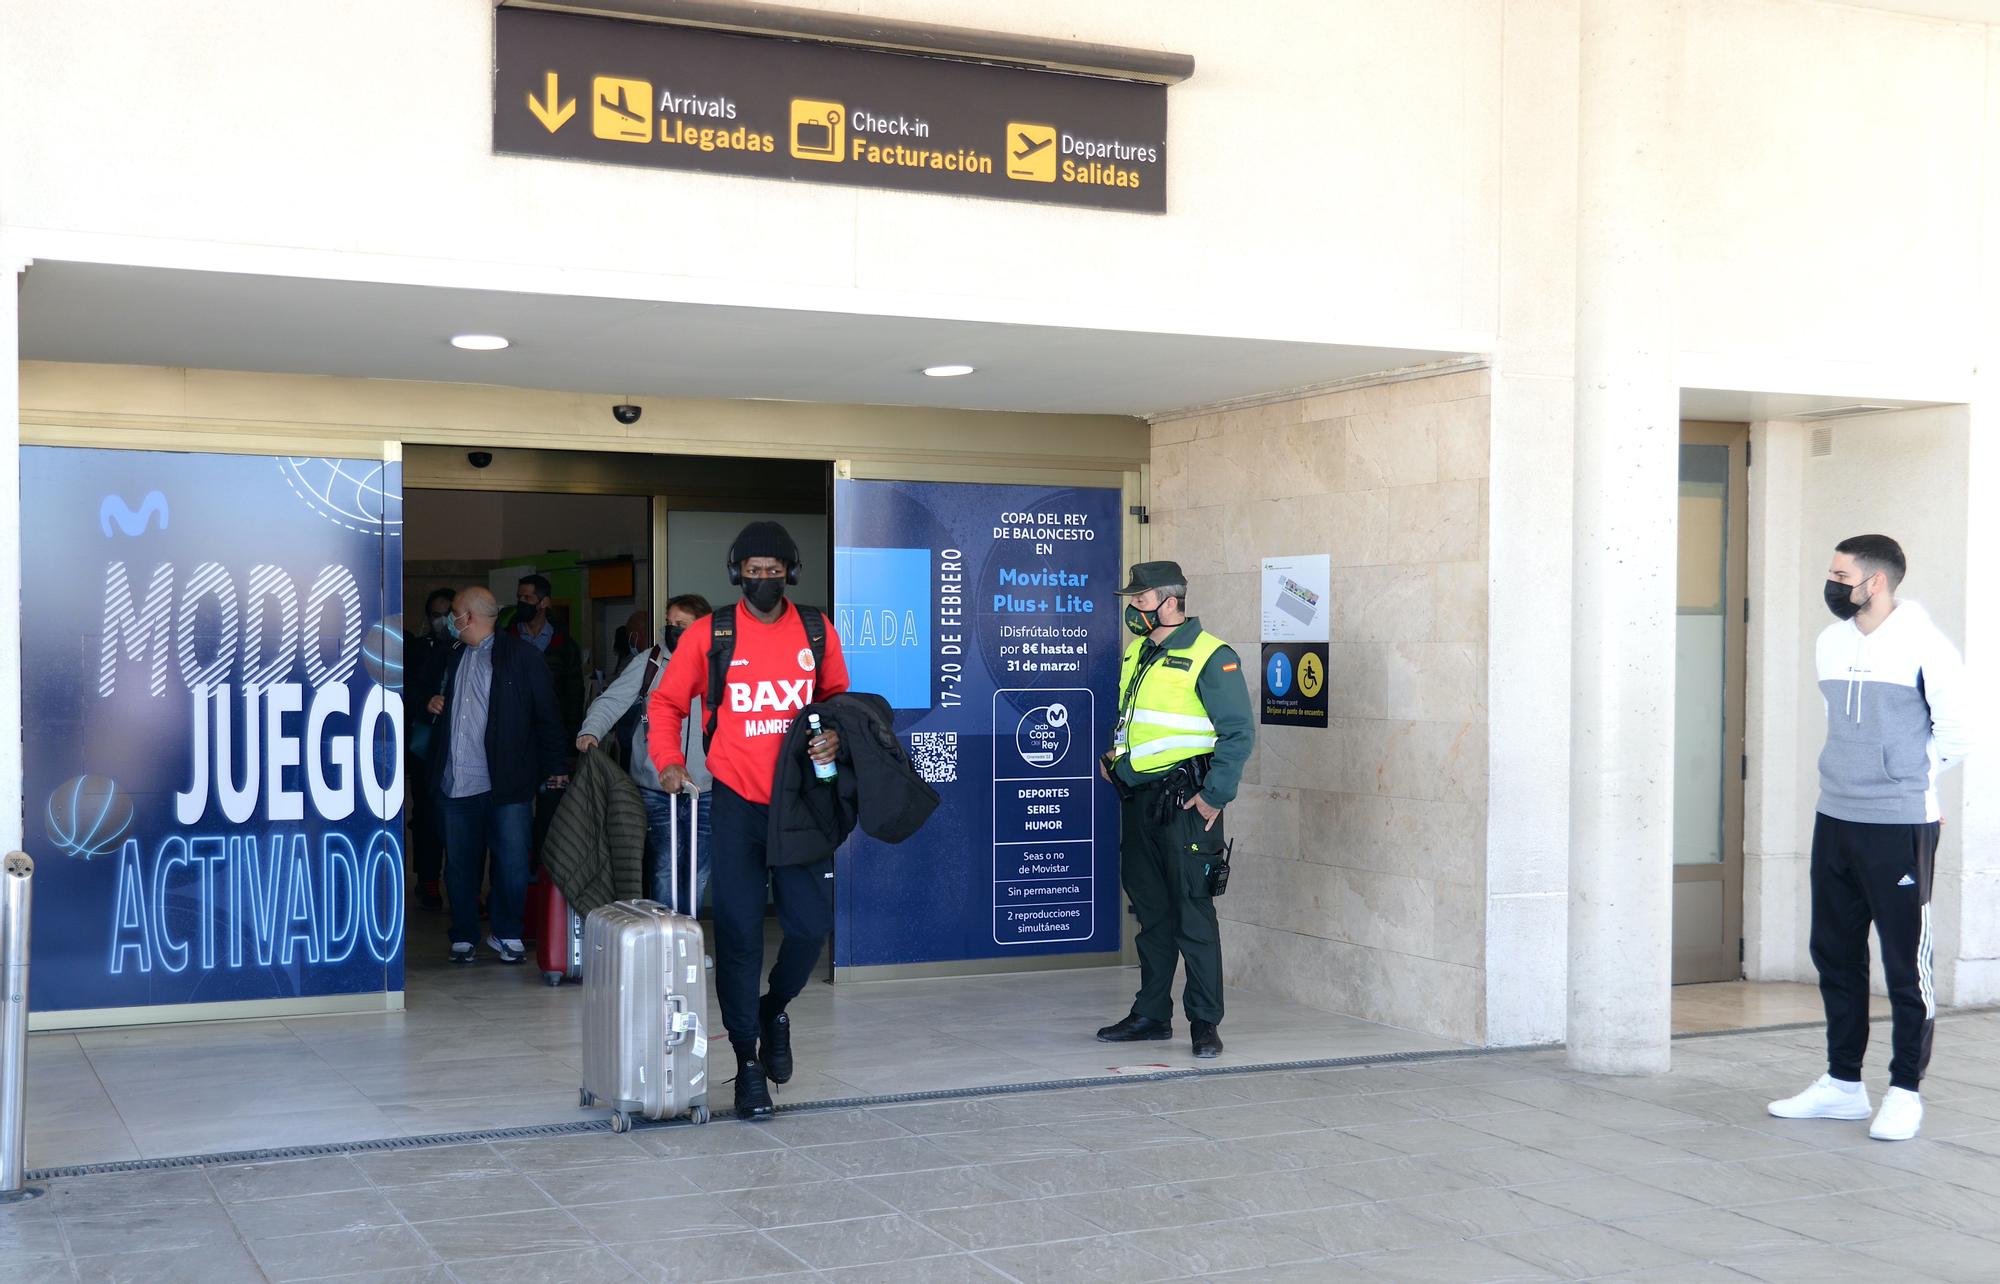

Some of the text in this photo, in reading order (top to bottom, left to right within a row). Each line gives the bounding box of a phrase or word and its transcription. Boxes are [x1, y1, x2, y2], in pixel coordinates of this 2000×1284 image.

[661, 92, 736, 119] Arrivals
[853, 112, 928, 137] Check-in
[661, 118, 774, 152] Llegadas
[1063, 135, 1156, 162] Departures
[853, 139, 991, 173] Facturación
[1063, 160, 1142, 187] Salidas
[1001, 512, 1087, 525] COPA DEL REY
[994, 528, 1094, 540] DE BALONCESTO
[1036, 544, 1052, 554] EN
[1000, 568, 1088, 586] Movistar
[941, 549, 961, 625] FEBRERO
[994, 595, 1093, 612] Plus+ Lite
[100, 561, 362, 698] MODO
[1062, 626, 1087, 637] todo
[941, 635, 961, 654] DE
[1001, 643, 1087, 657] por 8€ hasta el
[1008, 660, 1079, 671] 31 de marzo!
[728, 679, 814, 712] BAXI
[745, 719, 793, 738] MANRE
[1029, 729, 1055, 740] Copa
[1041, 740, 1060, 751] Rey
[176, 682, 404, 824] JUEGO
[1019, 789, 1069, 798] DEPORTES
[1028, 805, 1060, 814] SERIES
[1026, 821, 1062, 830] HUMOR
[1023, 851, 1065, 861] Seas o no
[1018, 863, 1070, 875] de Movistar
[1008, 885, 1080, 897] Sin permanencia
[110, 830, 404, 975] ACTIVADO
[1007, 908, 1081, 922] 2 reproducciones
[1017, 922, 1070, 933] simultáneas
